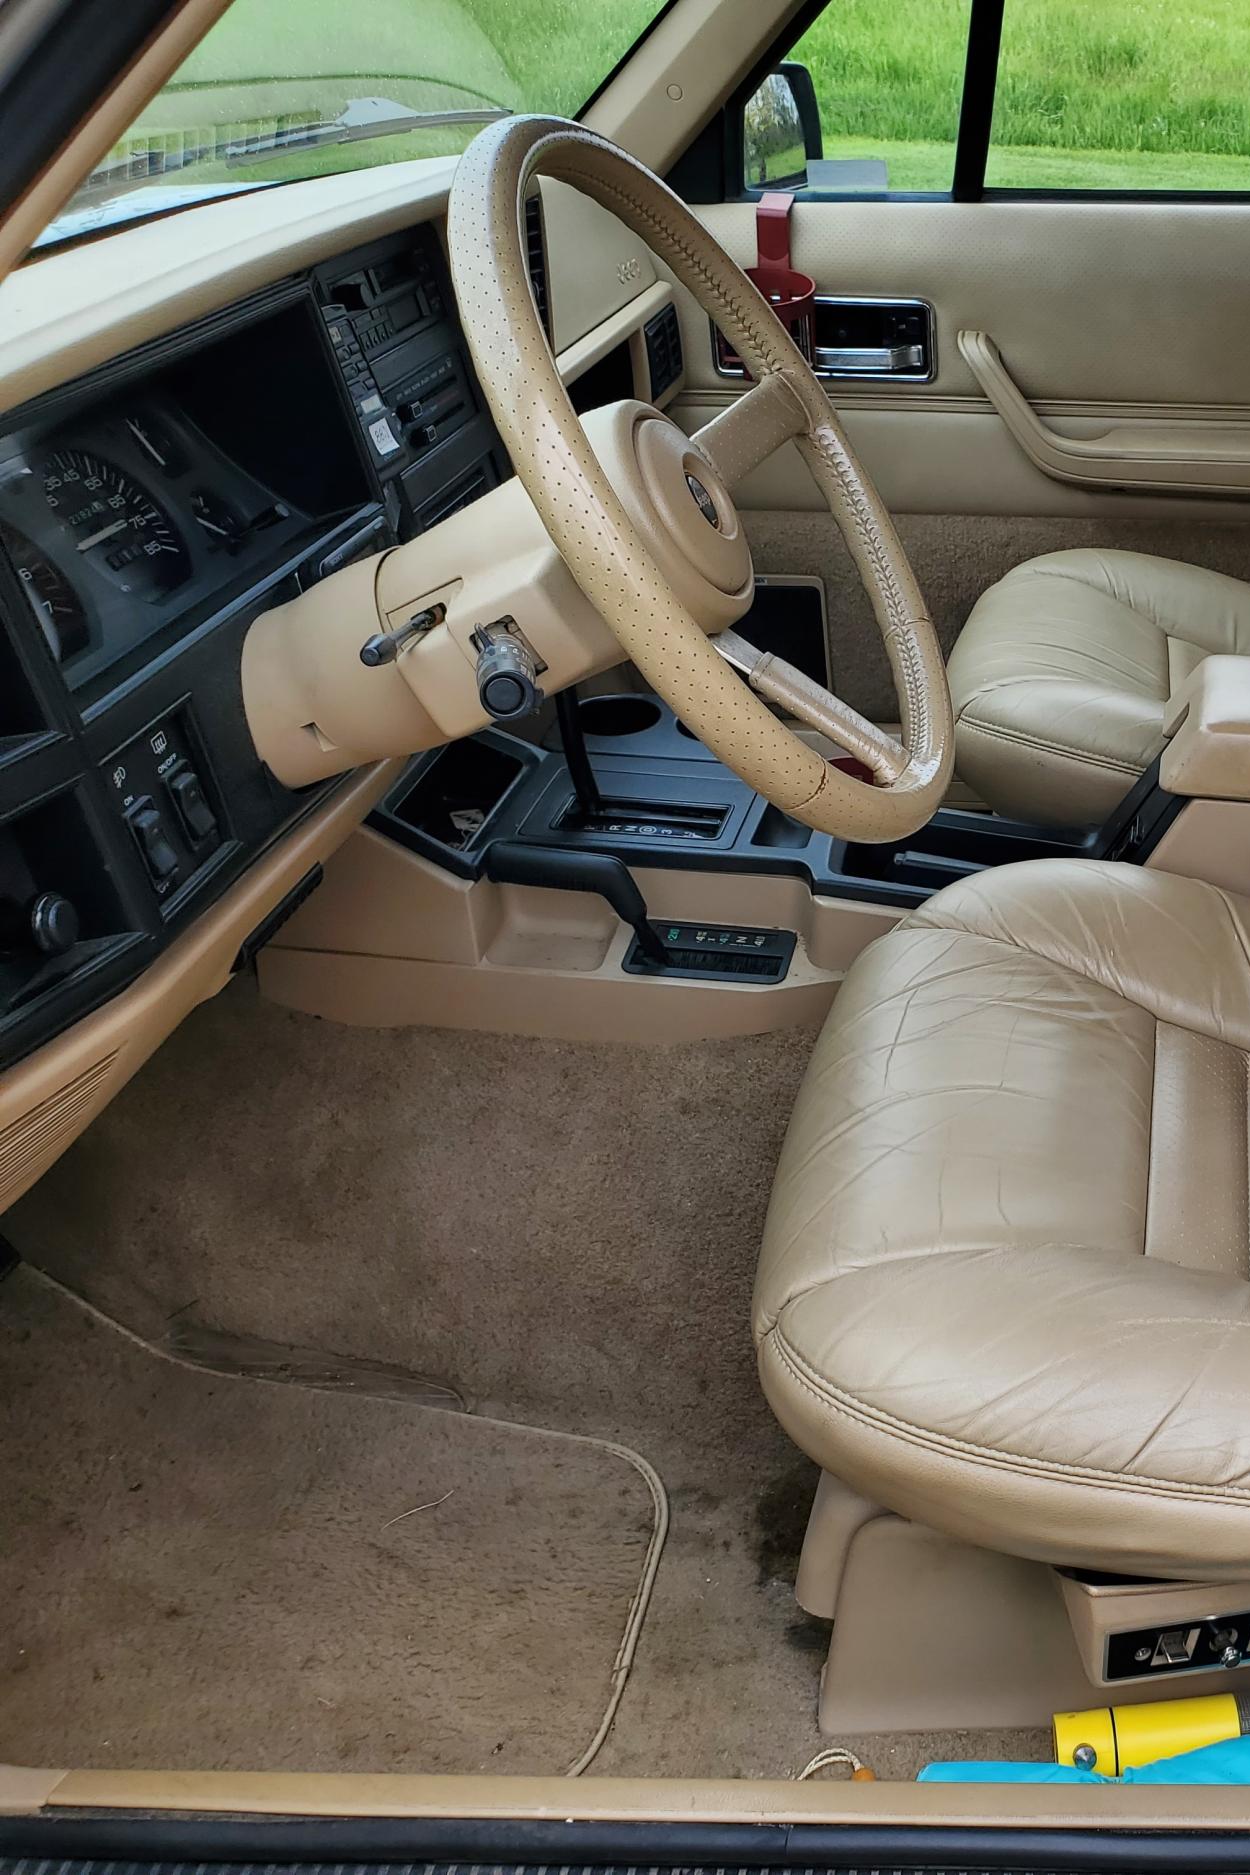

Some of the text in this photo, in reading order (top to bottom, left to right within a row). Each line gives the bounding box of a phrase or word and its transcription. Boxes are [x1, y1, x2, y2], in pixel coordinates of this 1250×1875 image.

[63, 469, 80, 483] 45
[84, 476, 103, 490] 55
[44, 476, 62, 491] 35
[128, 515, 147, 529] 75
[144, 541, 161, 556] 85
[18, 568, 32, 581] 6
[41, 600, 54, 613] 7
